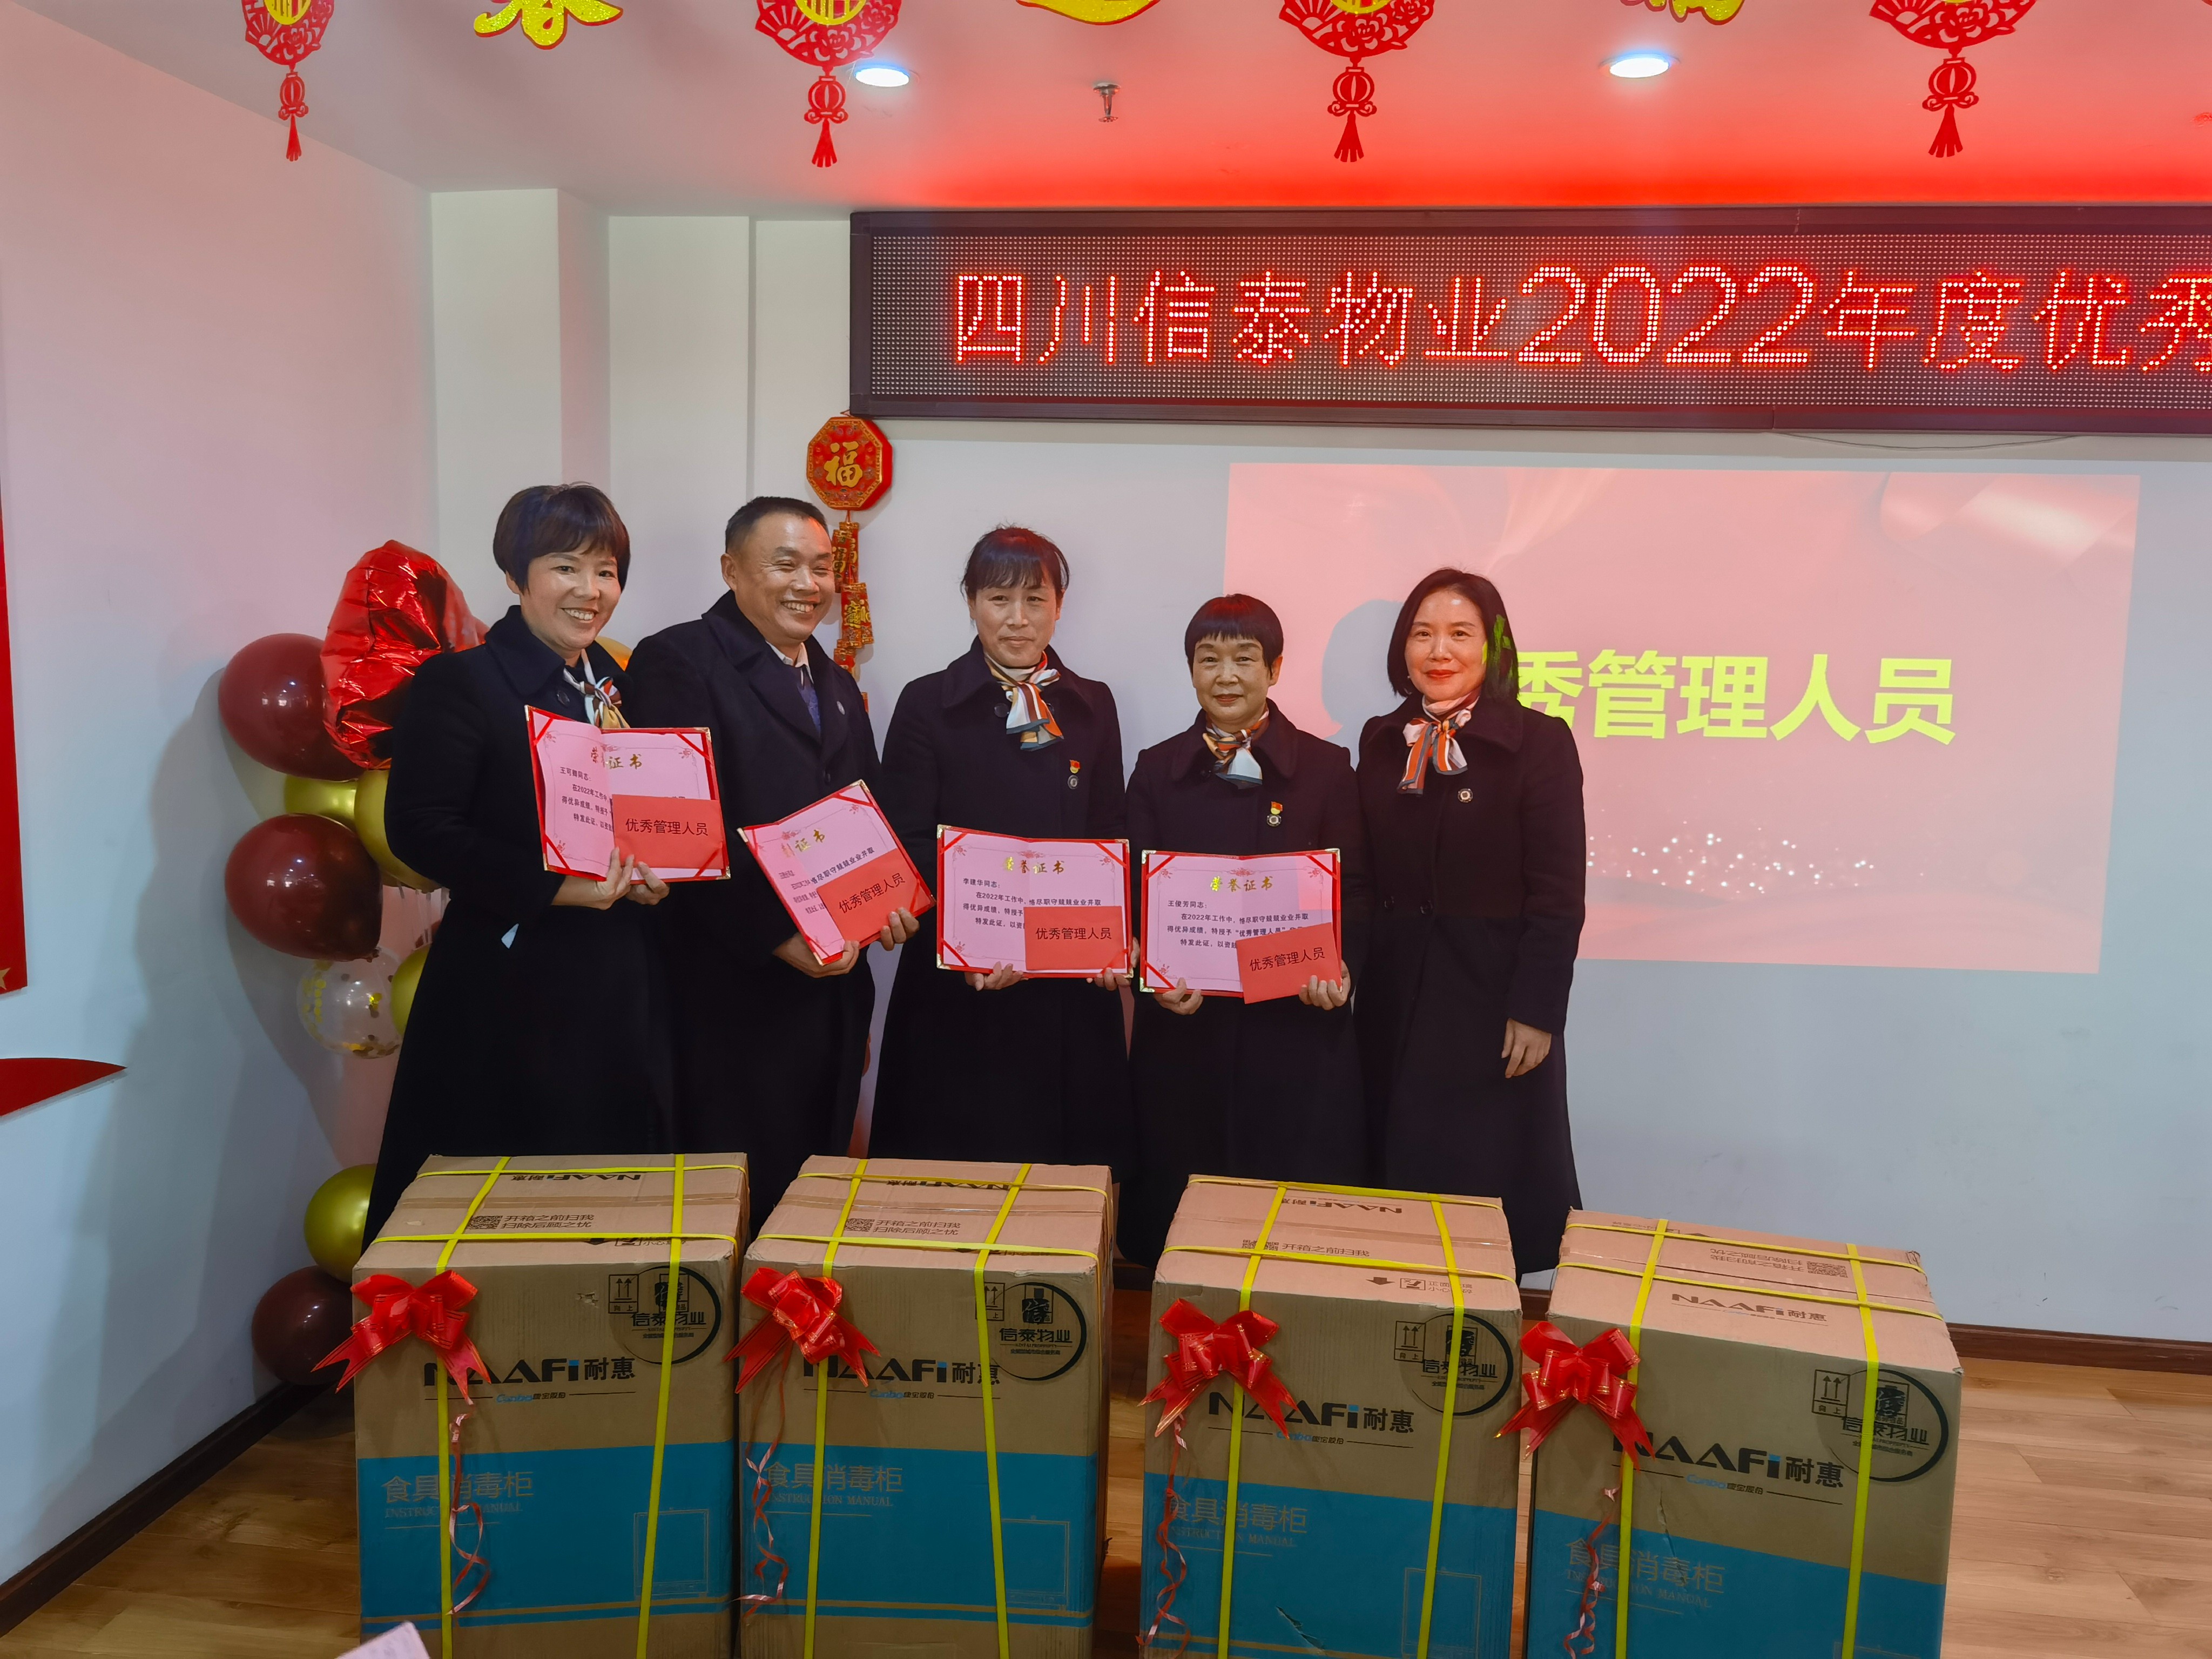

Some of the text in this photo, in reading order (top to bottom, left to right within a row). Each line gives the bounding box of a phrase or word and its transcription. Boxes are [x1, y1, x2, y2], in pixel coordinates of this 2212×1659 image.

[956, 265, 2212, 370] 四川信泰物业2022年度优秀
[824, 441, 863, 488] 福
[1488, 645, 1957, 746] 秀管理人员
[625, 818, 709, 837] 优秀管理人员
[839, 873, 906, 913] 优秀管理人员
[1035, 927, 1112, 940] 优秀管理人员
[1249, 947, 1325, 972] 优秀管理人员
[1672, 1293, 1784, 1316] NAAFi
[999, 1327, 1073, 1344] 信泰物业
[584, 1357, 636, 1381] 耐惠
[1363, 1407, 1414, 1433] 耐惠
[1785, 1456, 1844, 1488] 耐惠
